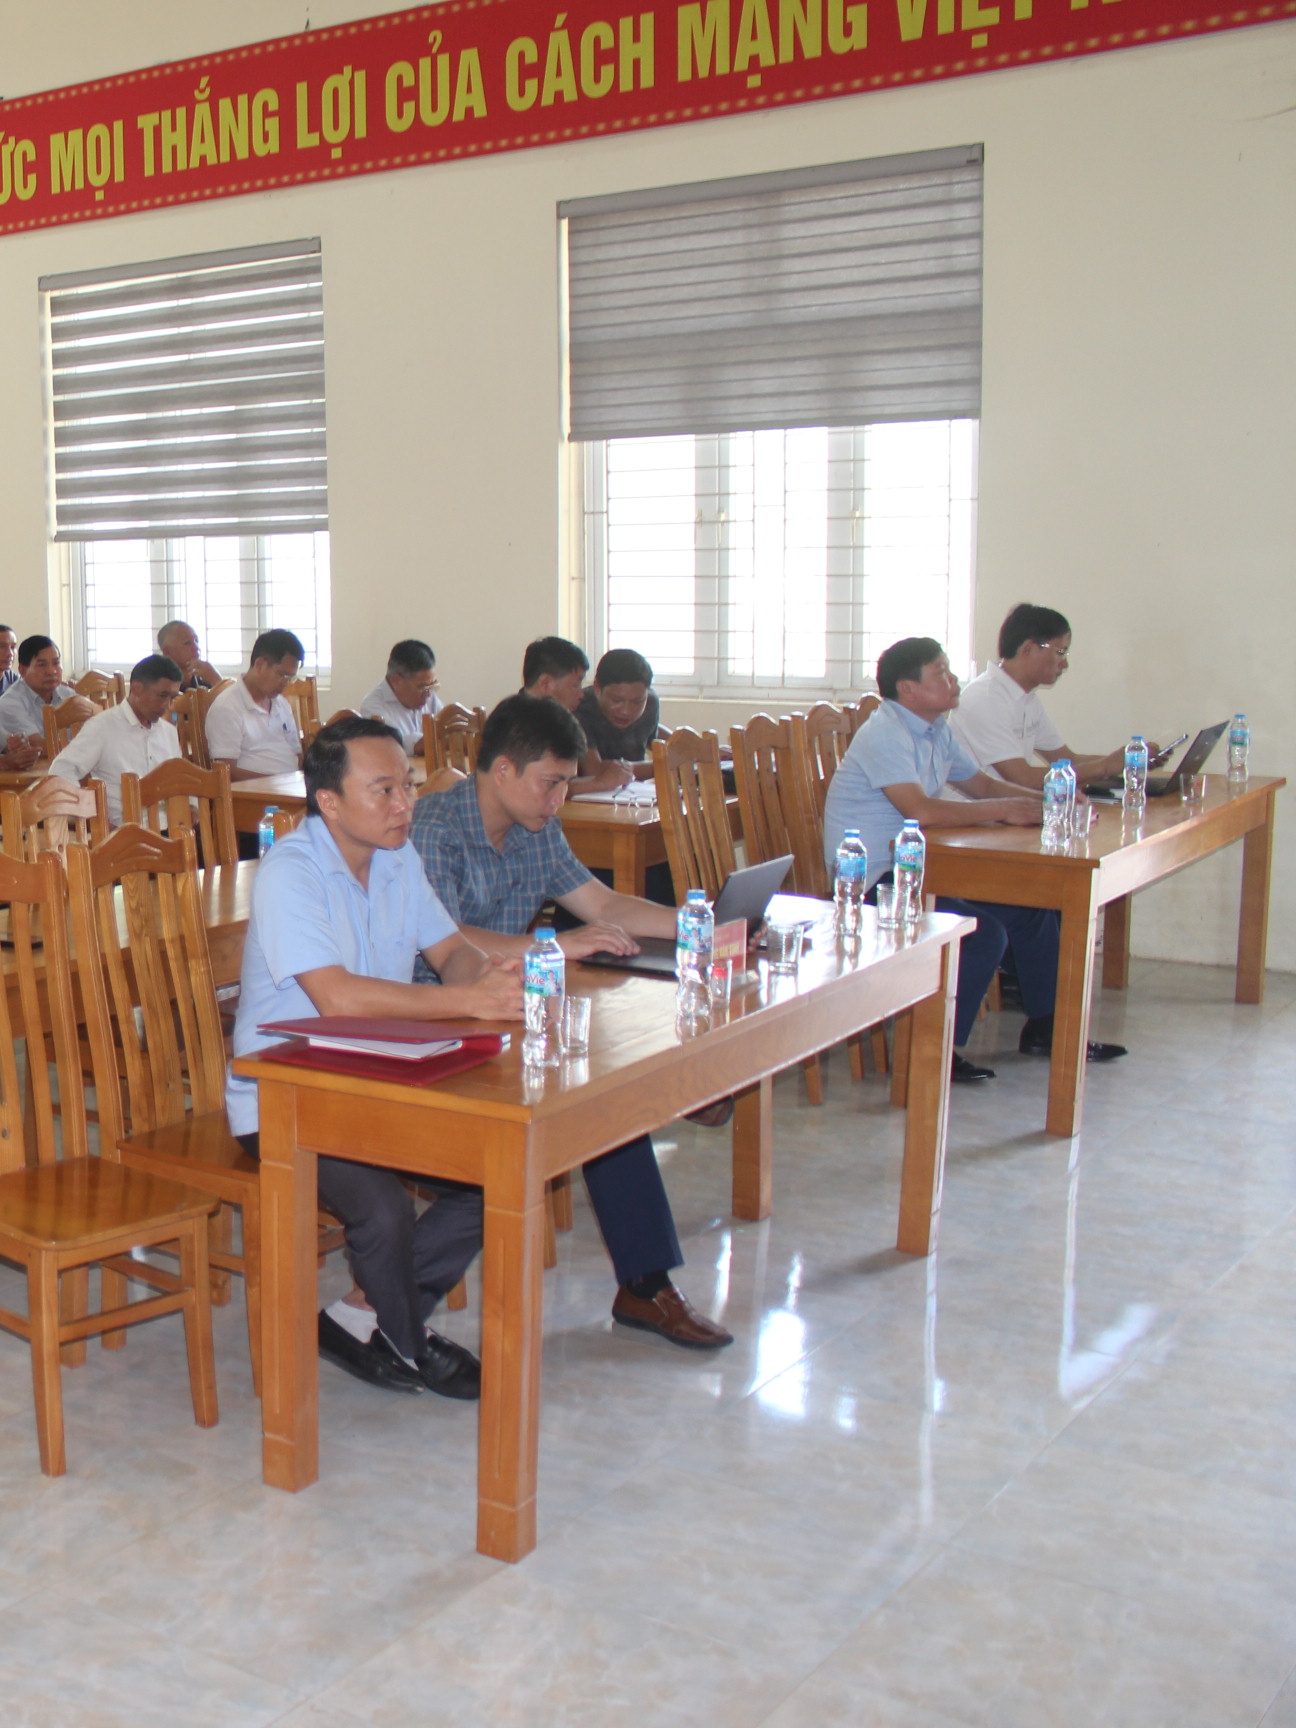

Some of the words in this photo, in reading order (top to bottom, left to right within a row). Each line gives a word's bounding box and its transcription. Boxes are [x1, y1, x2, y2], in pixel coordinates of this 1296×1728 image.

[50, 120, 125, 201] MỌI
[137, 76, 280, 177] THẮNG
[297, 66, 367, 159] LỢI
[385, 30, 488, 131] CỦA
[506, 6, 654, 111] CÁCH
